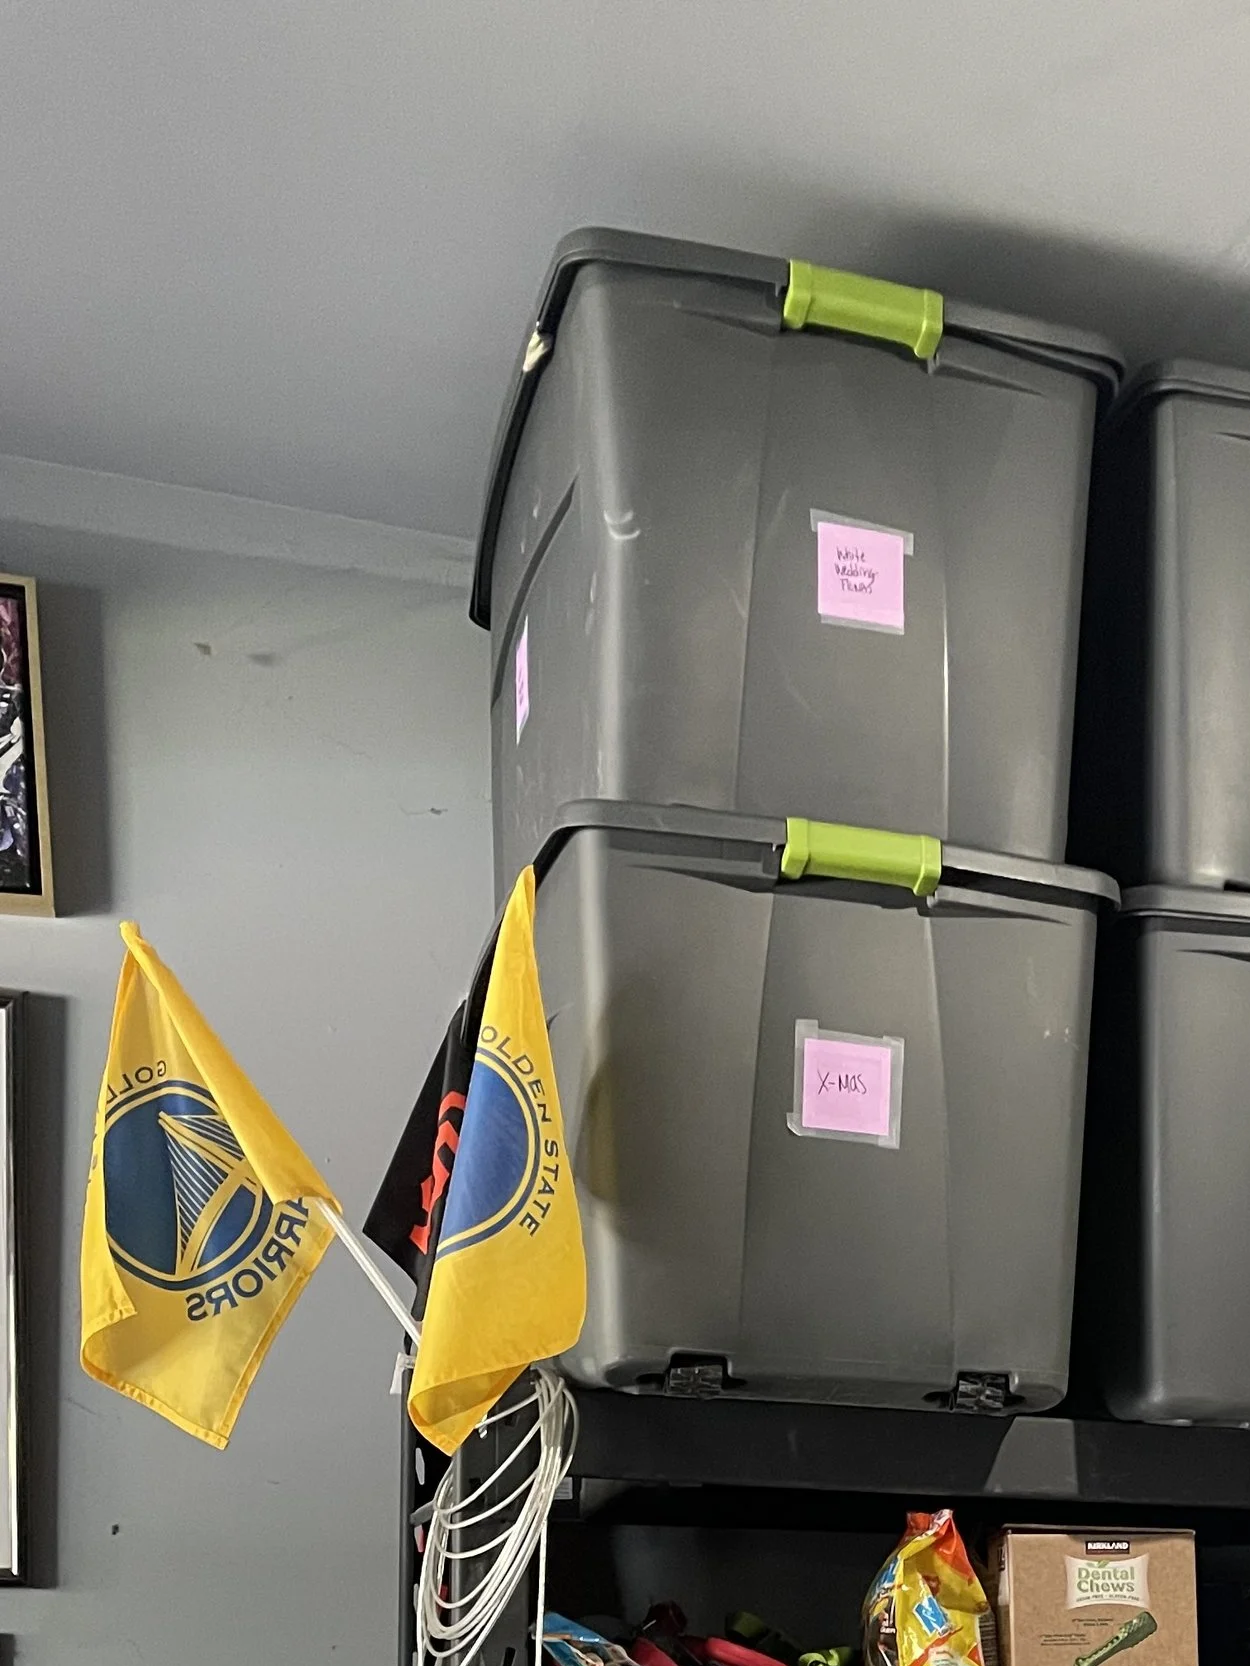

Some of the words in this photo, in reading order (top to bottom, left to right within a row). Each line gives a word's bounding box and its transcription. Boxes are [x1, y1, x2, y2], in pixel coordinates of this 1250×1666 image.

[480, 1025, 552, 1124] OLDEN
[518, 1138, 560, 1238] STATE
[1078, 1566, 1135, 1581] Dental
[1076, 1579, 1135, 1593] Chews
